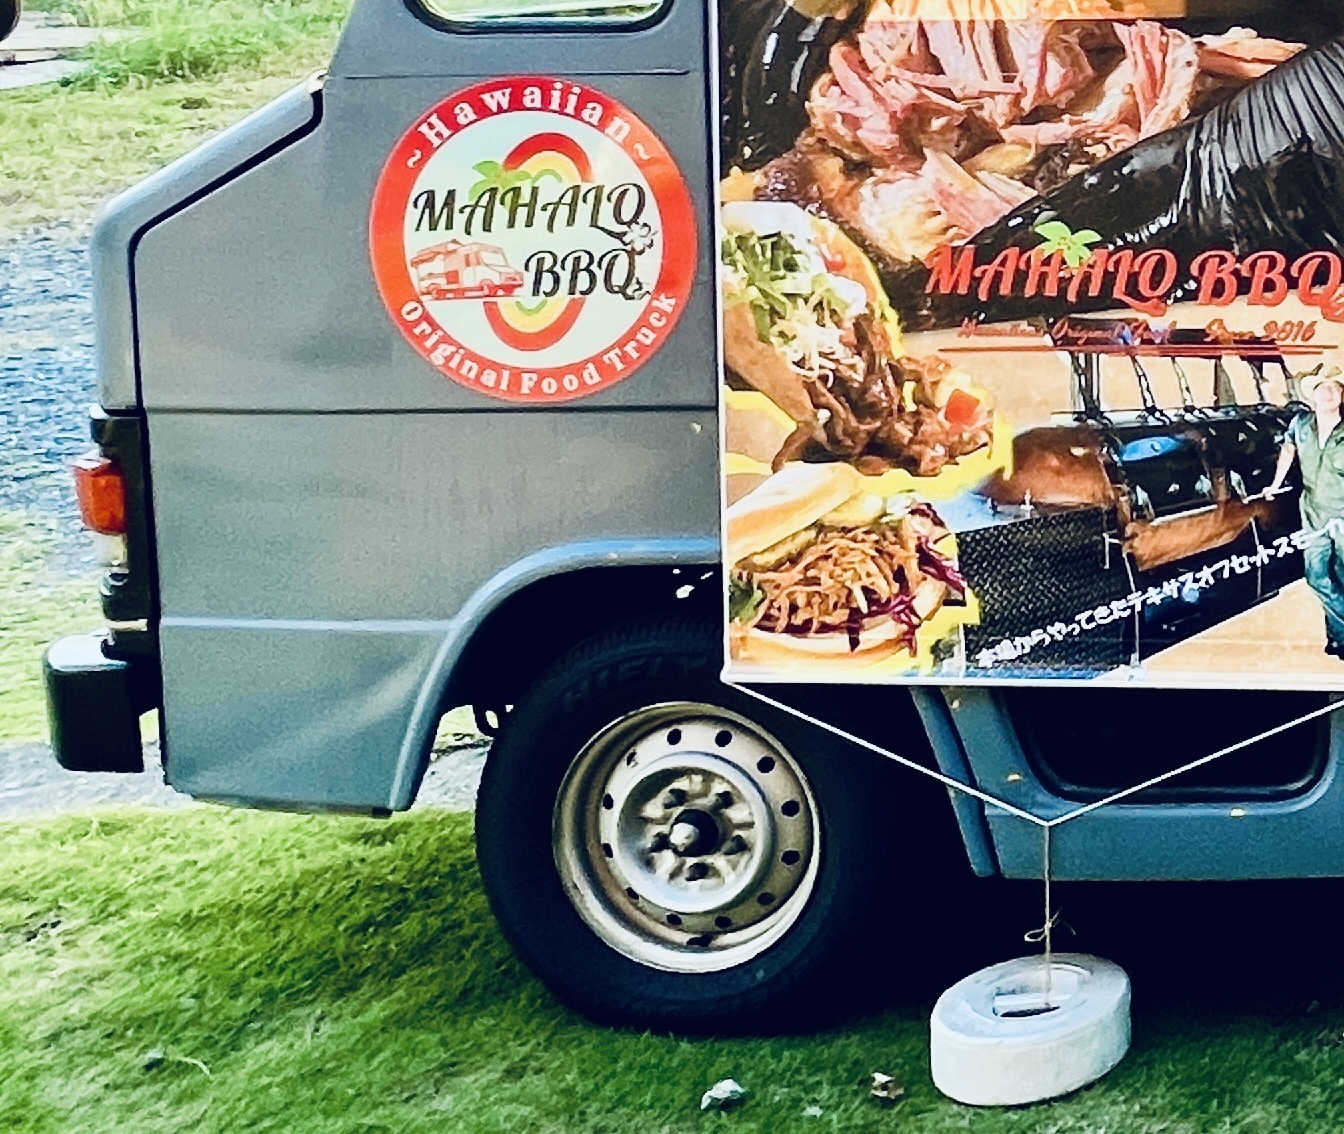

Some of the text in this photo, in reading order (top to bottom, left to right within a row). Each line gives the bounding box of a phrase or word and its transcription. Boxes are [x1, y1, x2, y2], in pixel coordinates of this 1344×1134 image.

[416, 80, 634, 149] Hawaiian
[412, 182, 648, 244] MAHALO
[523, 248, 649, 300] BBQ
[924, 244, 1178, 316] MAHALO
[400, 292, 678, 394] Original Food Truck
